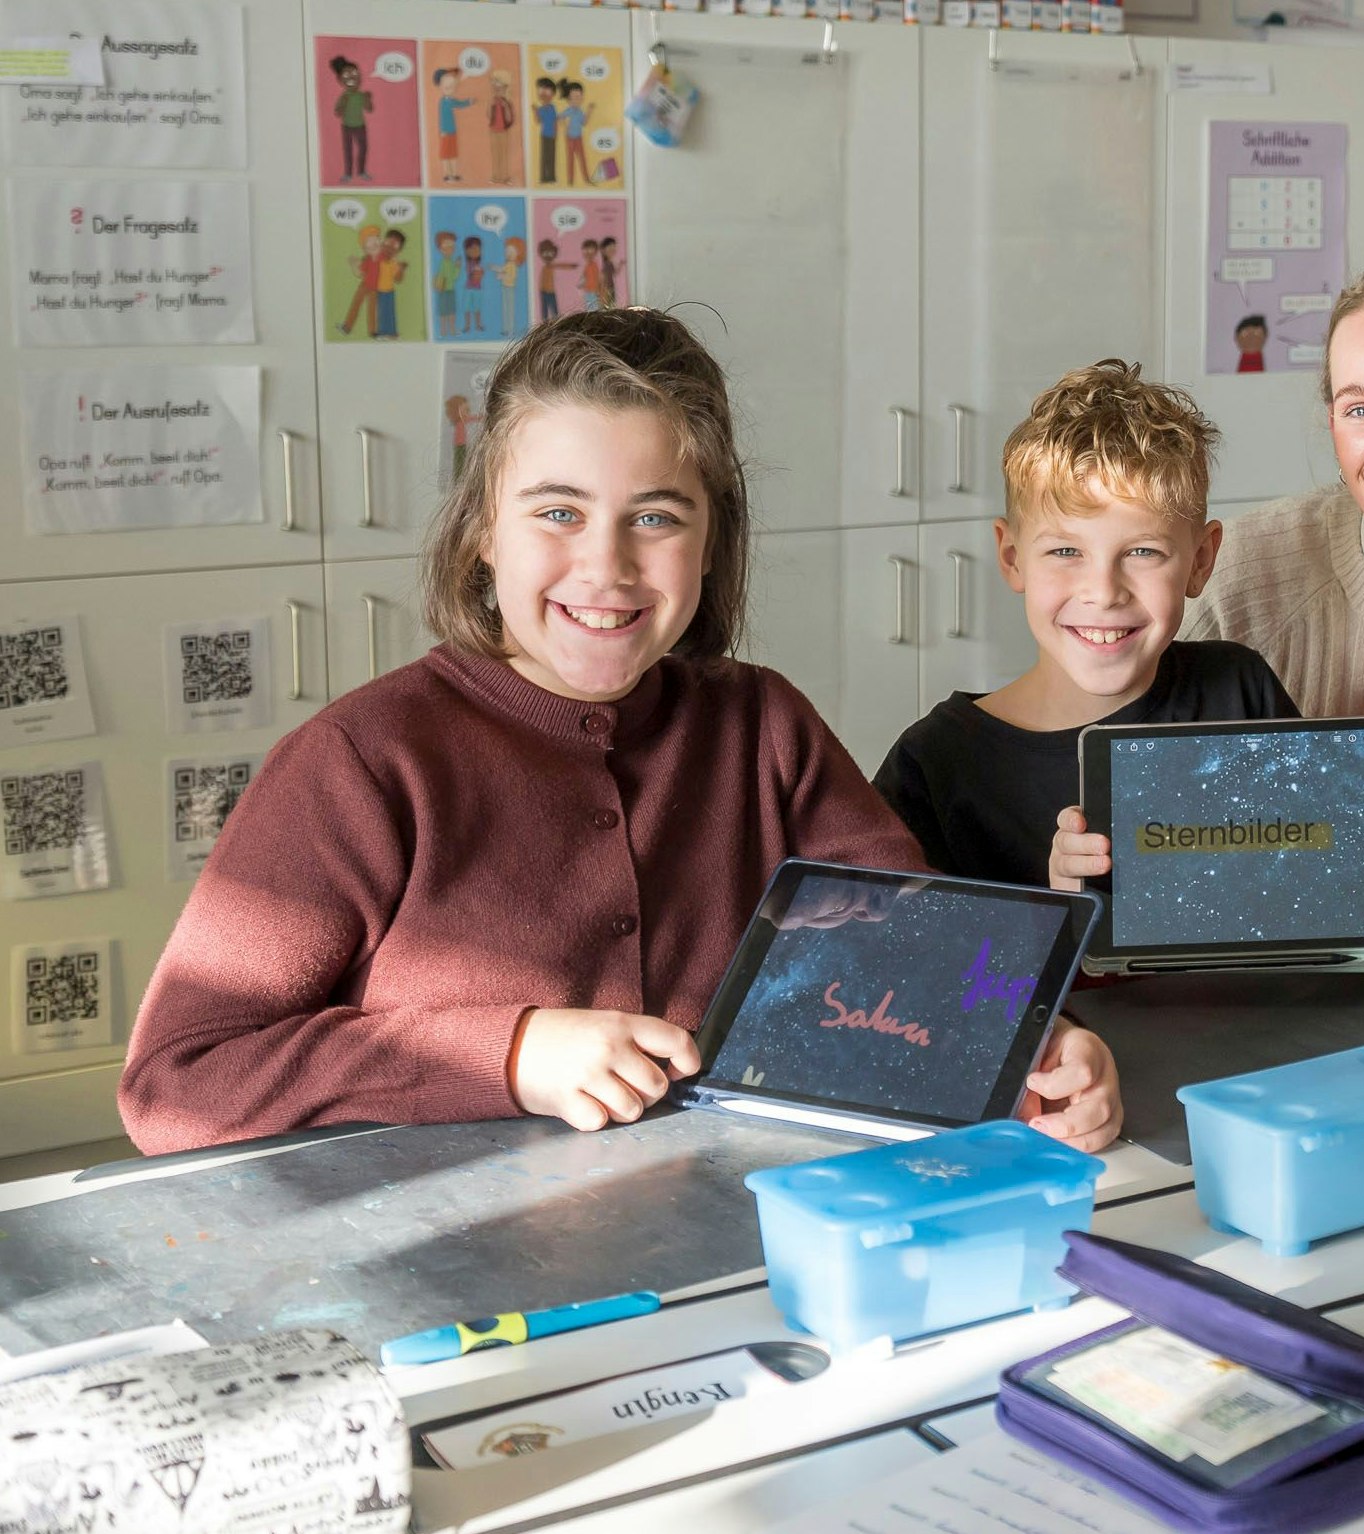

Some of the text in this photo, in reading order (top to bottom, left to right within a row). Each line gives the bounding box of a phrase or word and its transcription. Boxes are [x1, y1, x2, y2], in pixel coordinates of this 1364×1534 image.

[101, 35, 199, 59] Aussagesatz
[382, 60, 405, 75] ich
[465, 54, 483, 69] du
[545, 59, 561, 70] er
[584, 64, 605, 77] sie
[596, 138, 613, 148] es
[334, 208, 359, 220] wir
[386, 205, 410, 217] wir
[481, 211, 501, 225] ihr
[556, 213, 578, 226] sie
[92, 214, 119, 235] Der
[124, 214, 199, 240] Fragesatz
[146, 269, 162, 283] du
[68, 296, 86, 310] du
[91, 403, 118, 422] Der
[122, 398, 211, 424] Ausrufesatz
[1143, 816, 1315, 849] Sternbilder
